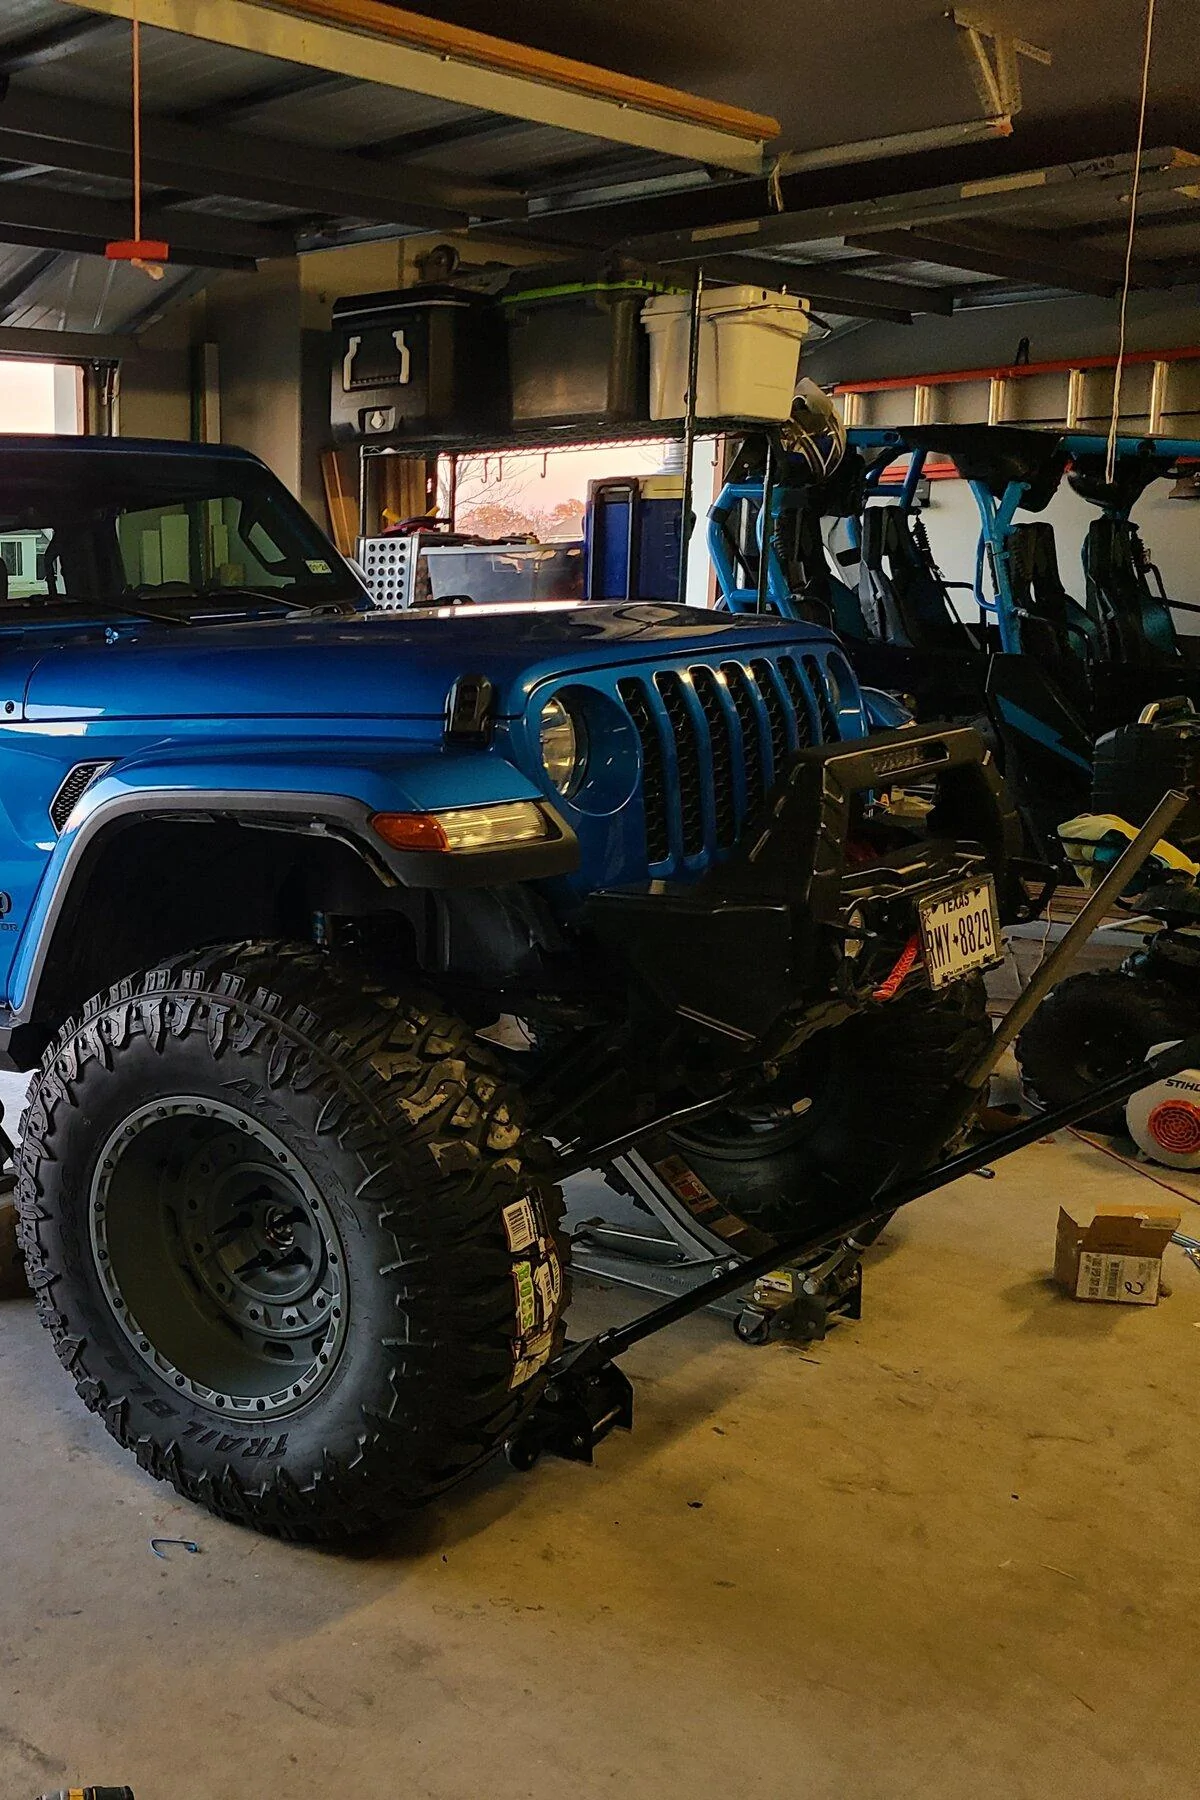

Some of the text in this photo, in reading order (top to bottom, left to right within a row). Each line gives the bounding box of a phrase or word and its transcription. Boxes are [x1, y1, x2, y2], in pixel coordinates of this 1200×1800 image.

[942, 893, 970, 915] TEXAS
[959, 908, 991, 956] 8829
[182, 1421, 290, 1460] TRAIL
